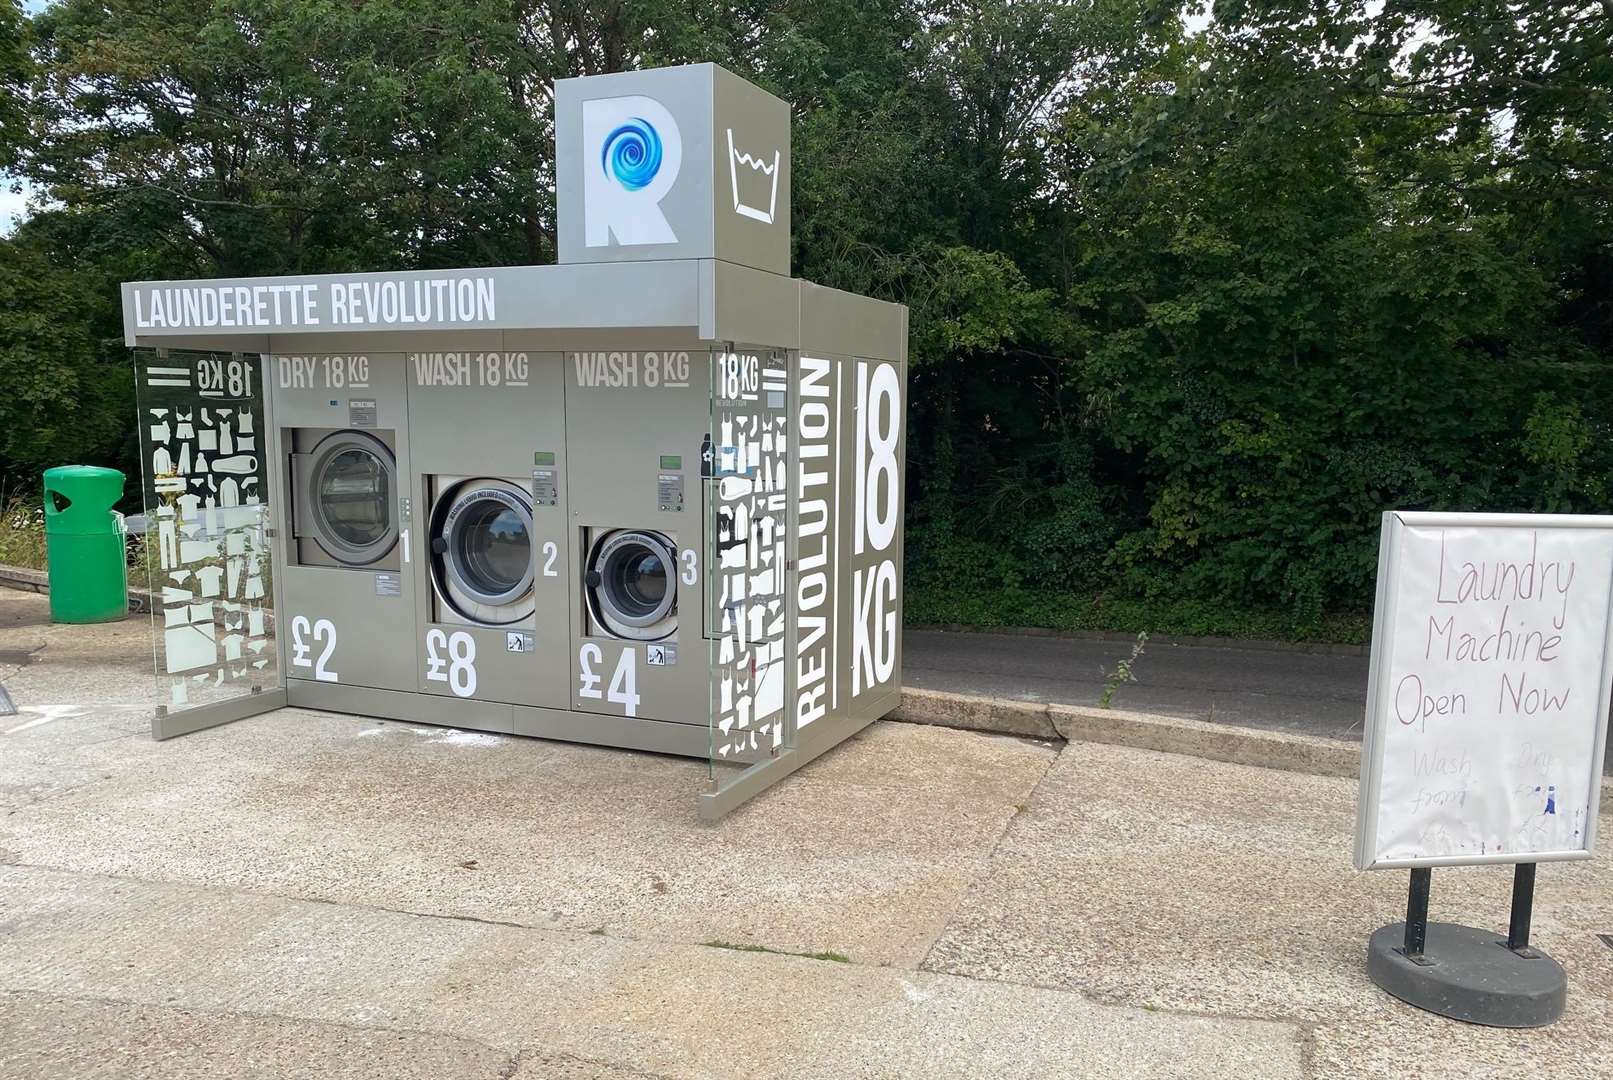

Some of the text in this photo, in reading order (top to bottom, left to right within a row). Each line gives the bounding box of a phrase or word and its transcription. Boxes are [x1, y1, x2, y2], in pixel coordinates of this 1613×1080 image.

[583, 95, 682, 247] R
[134, 278, 496, 328] LAUNDERETTE REVOLUTION
[279, 356, 369, 388] DRY 18 KG
[415, 352, 529, 386] WASH 18 KG
[574, 352, 689, 387] WASH 8 KG
[720, 353, 758, 400] 18 KG
[854, 361, 900, 555] 18
[400, 529, 410, 564] 1
[542, 541, 558, 577] 2
[681, 549, 697, 585] 3
[797, 357, 830, 730] REVOLUTION
[1437, 529, 1575, 631] Laundry
[291, 615, 338, 683] £2
[852, 559, 897, 698] KG
[1426, 605, 1562, 662] Machine
[426, 628, 477, 698] £8
[579, 642, 641, 718] £4
[1396, 672, 1571, 734] Open Now
